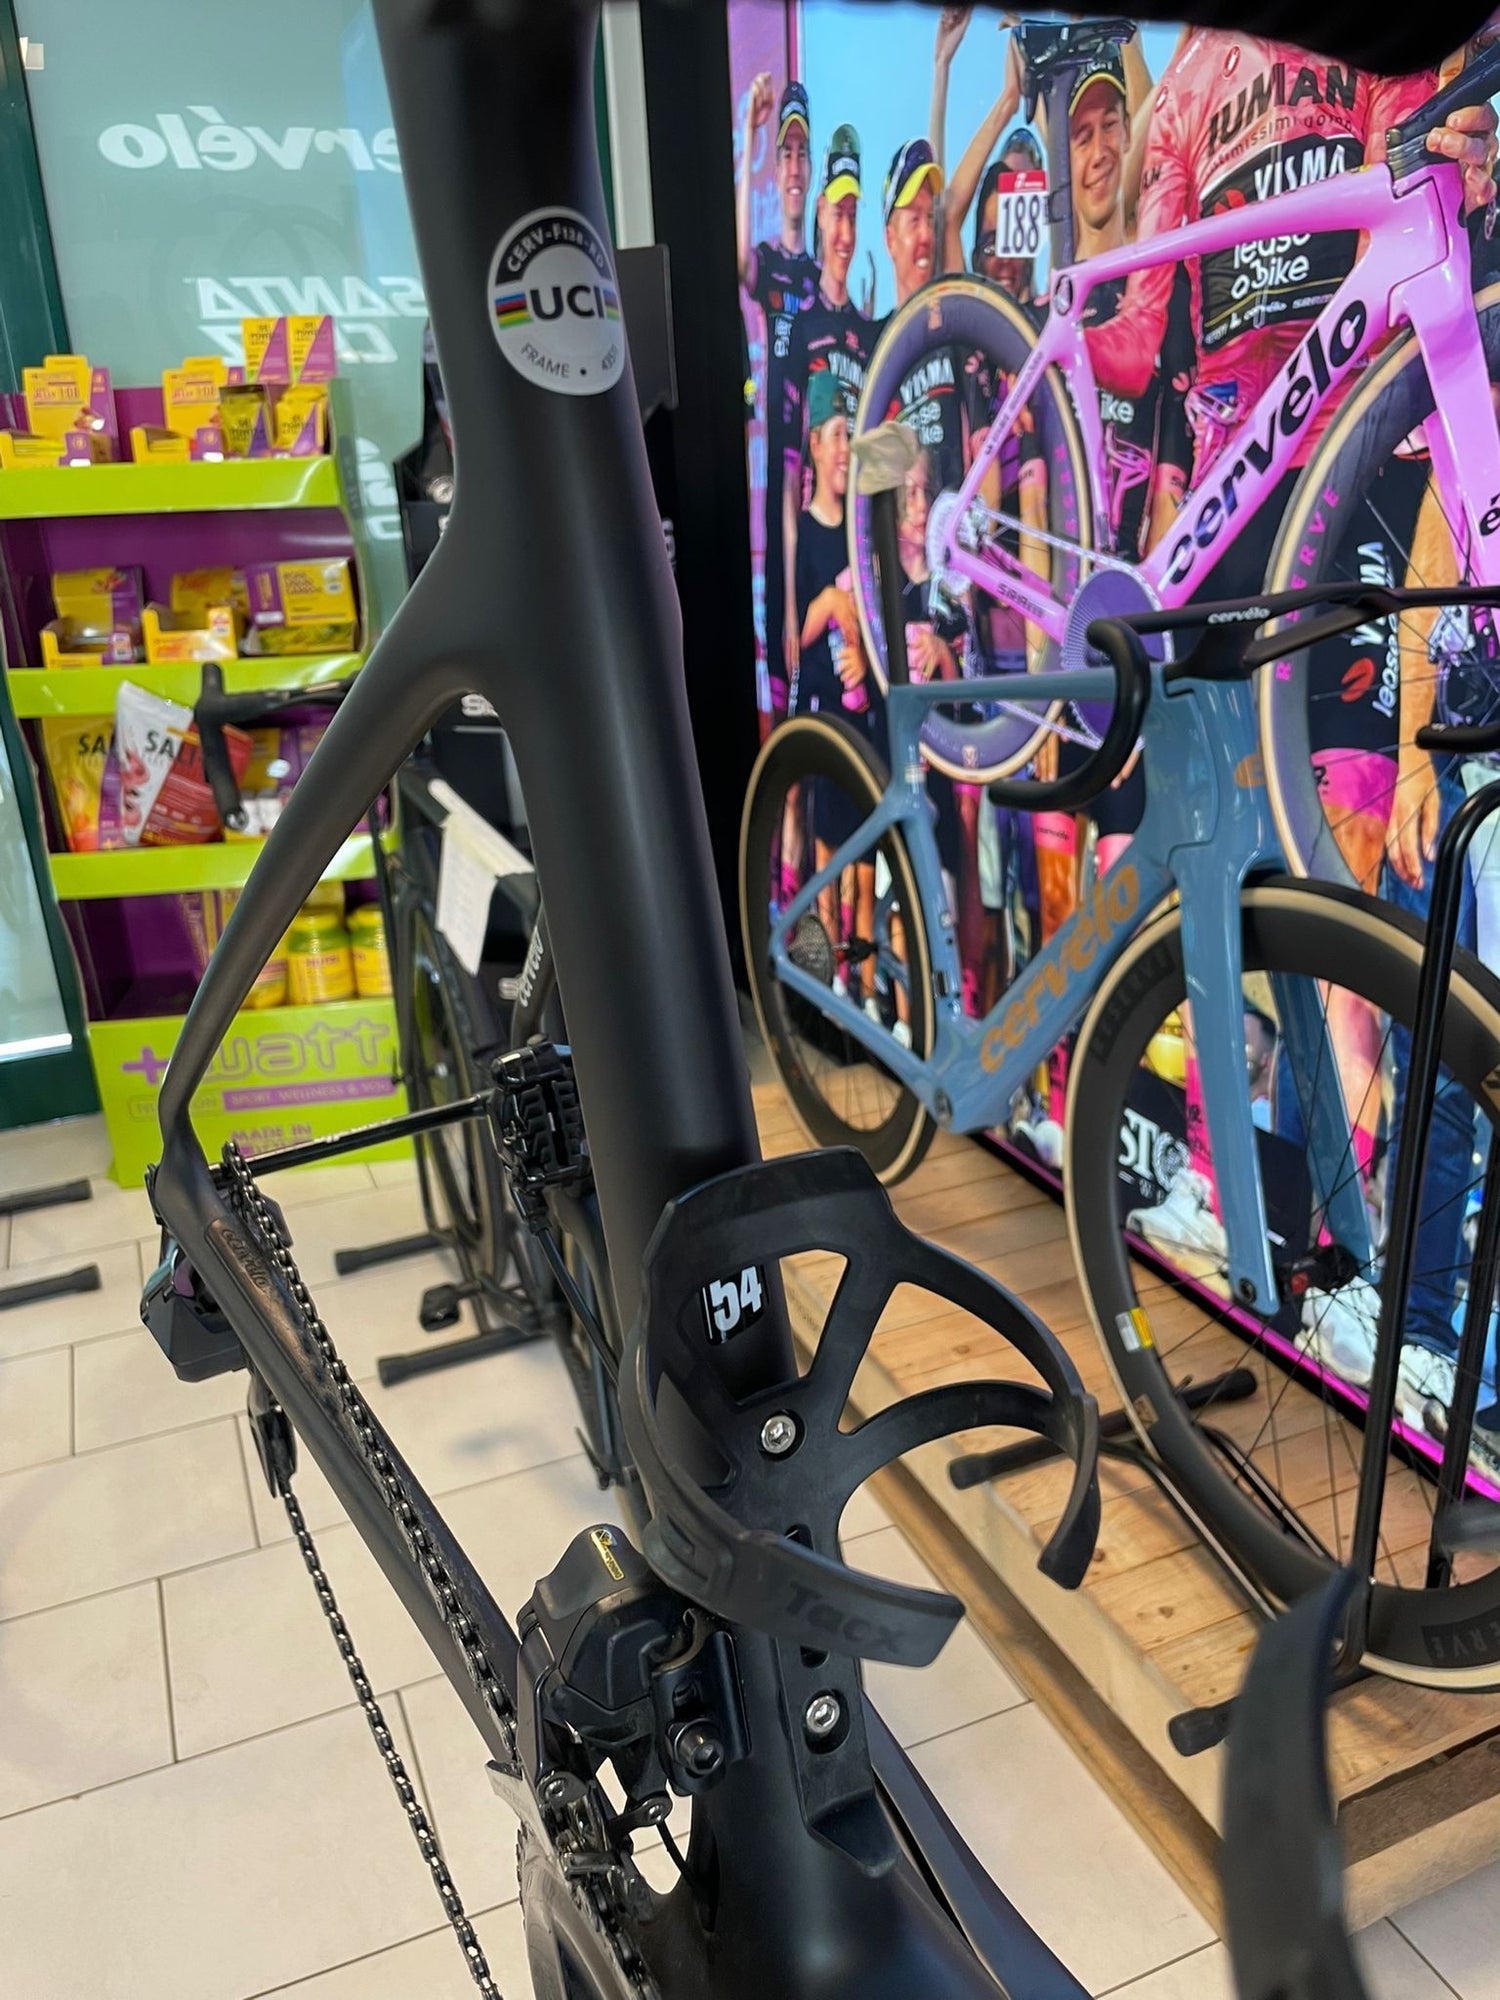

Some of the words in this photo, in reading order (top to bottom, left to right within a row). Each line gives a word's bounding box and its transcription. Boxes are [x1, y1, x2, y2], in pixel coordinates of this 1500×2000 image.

[1254, 145, 1345, 201] VISMA
[1001, 194, 1040, 254] 188
[530, 285, 604, 321] UCI
[521, 342, 571, 379] FRAME
[900, 357, 955, 405] VISMA
[1101, 392, 1135, 424] ike
[1169, 300, 1367, 584] cervélo
[1208, 607, 1271, 624] cervélo
[980, 864, 1140, 1074] cervélo
[709, 1265, 764, 1332] 54
[787, 1578, 906, 1653] Tacx
